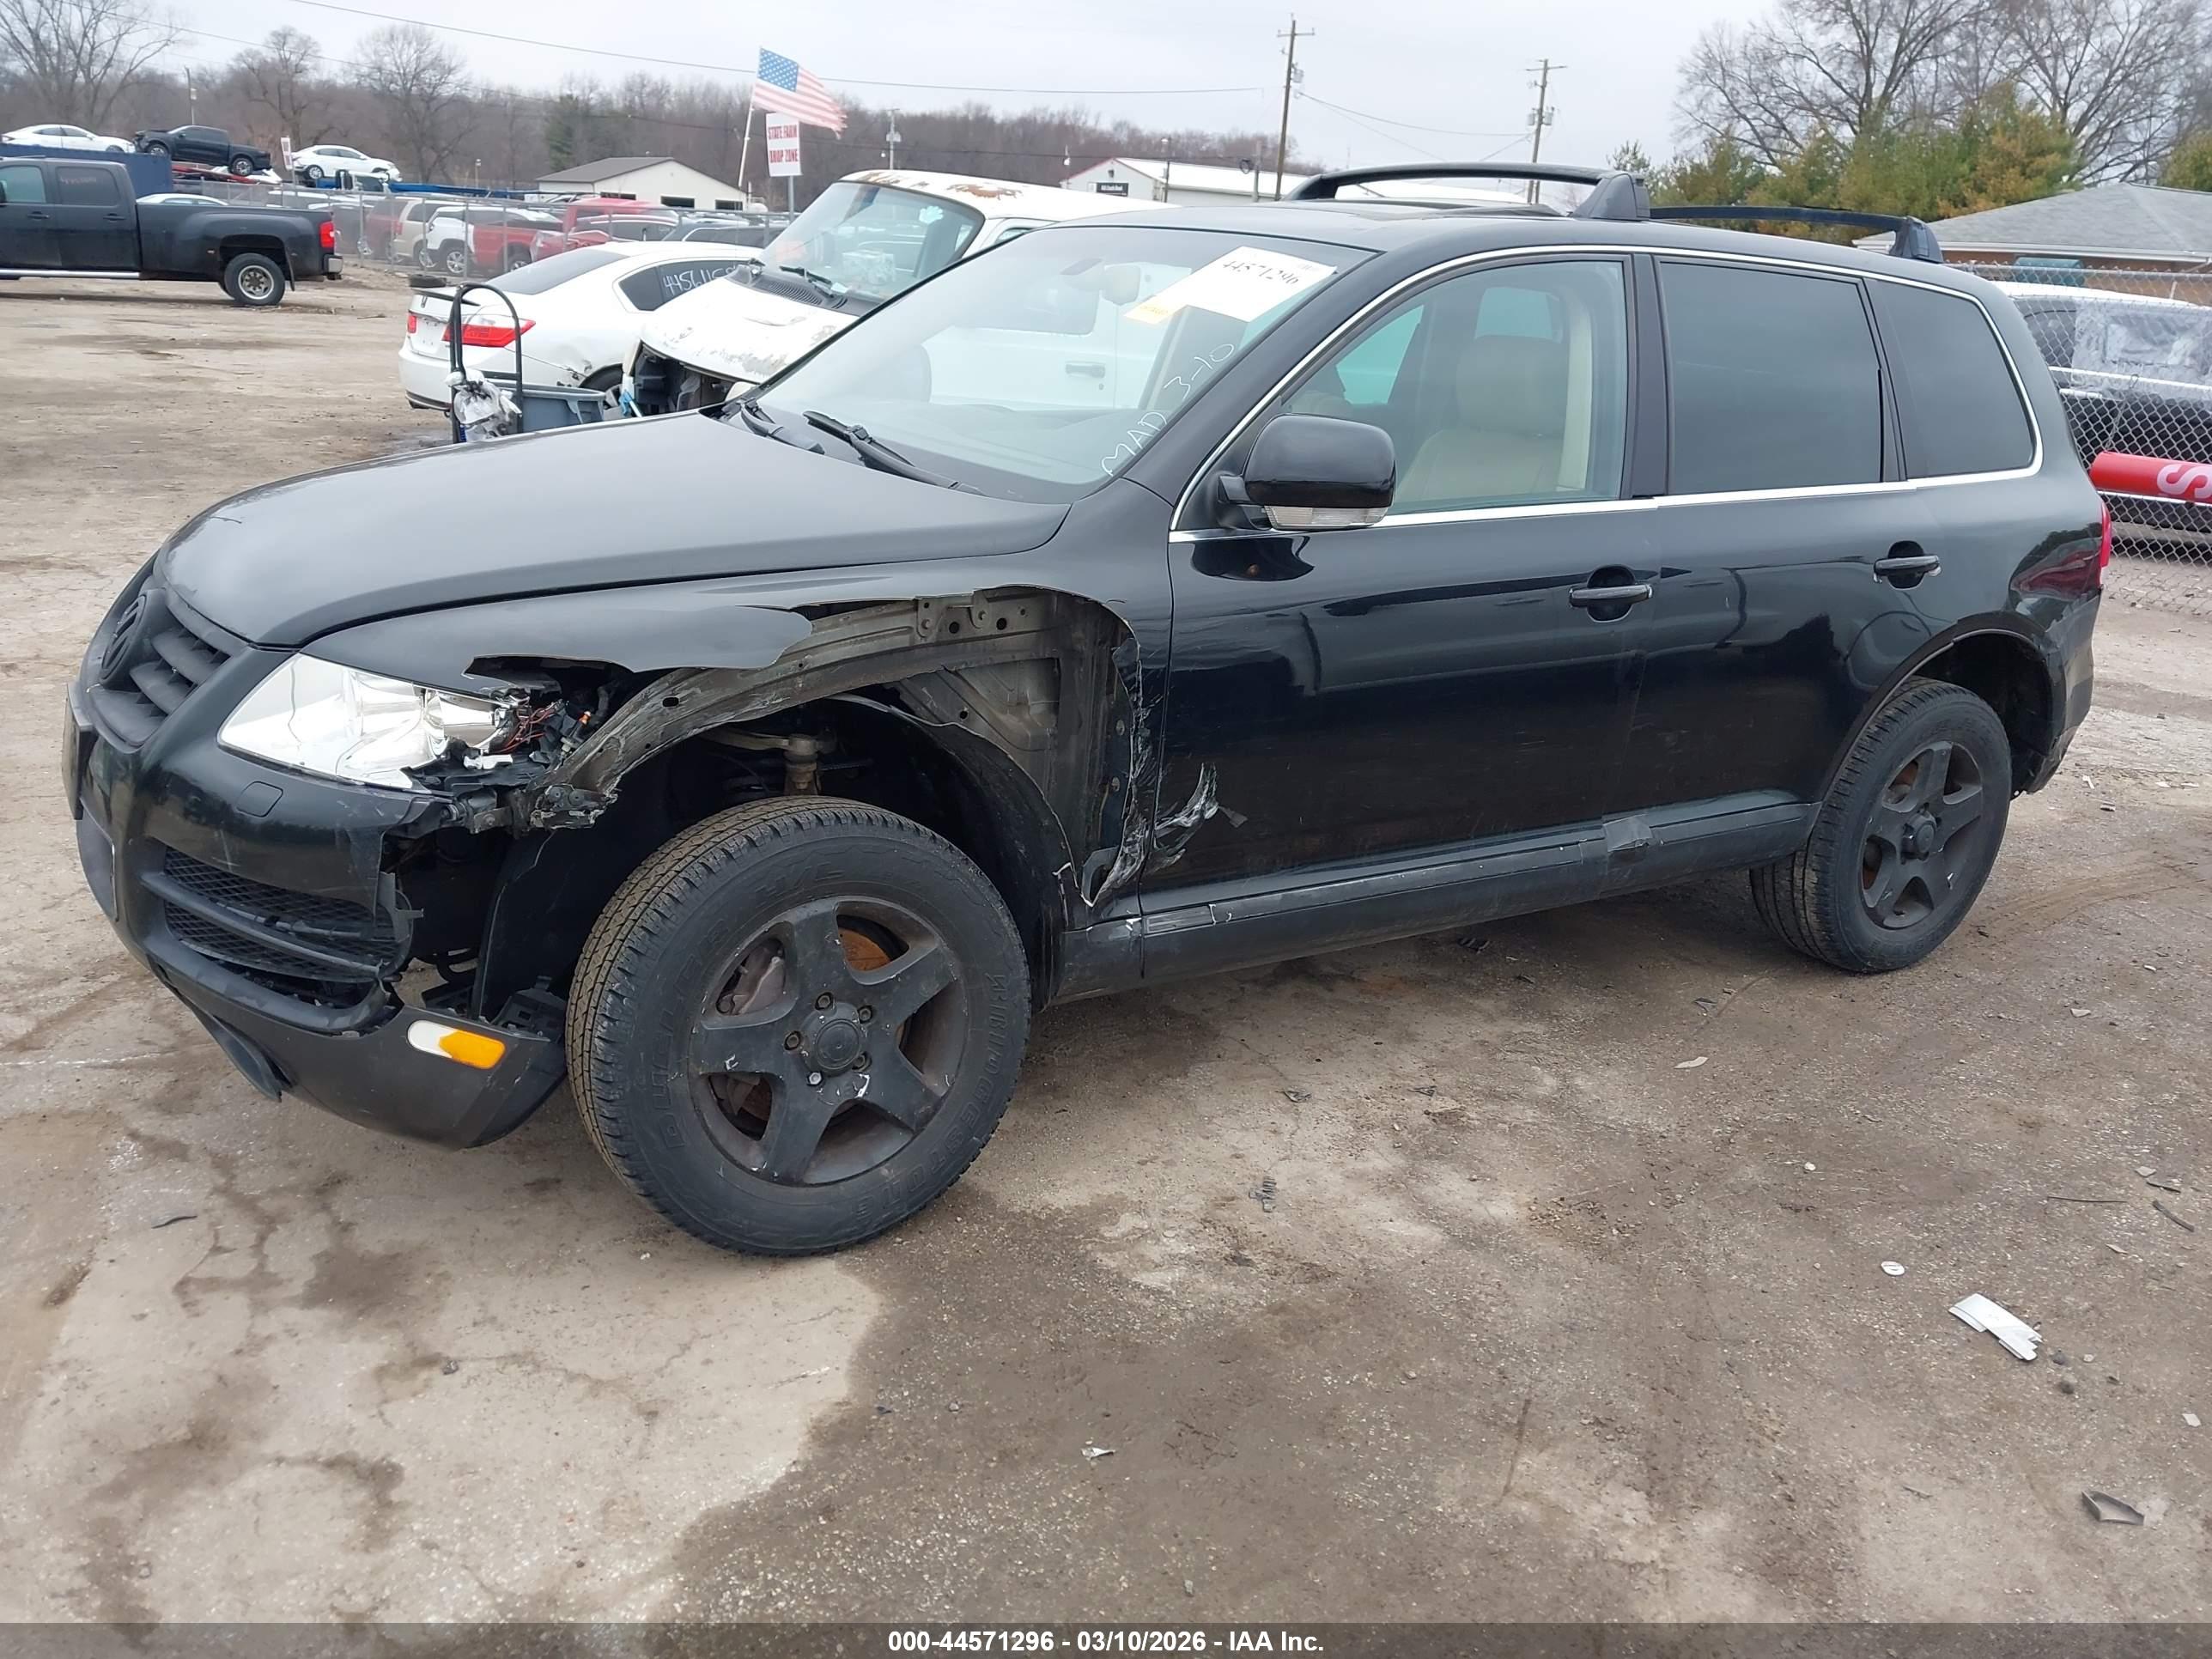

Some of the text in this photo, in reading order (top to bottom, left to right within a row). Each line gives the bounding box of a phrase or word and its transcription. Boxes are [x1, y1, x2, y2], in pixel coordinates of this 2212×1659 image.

[769, 124, 798, 140] STATE FARM
[769, 149, 799, 163] DROP ZONE
[1101, 343, 1236, 477] MAD 3-10
